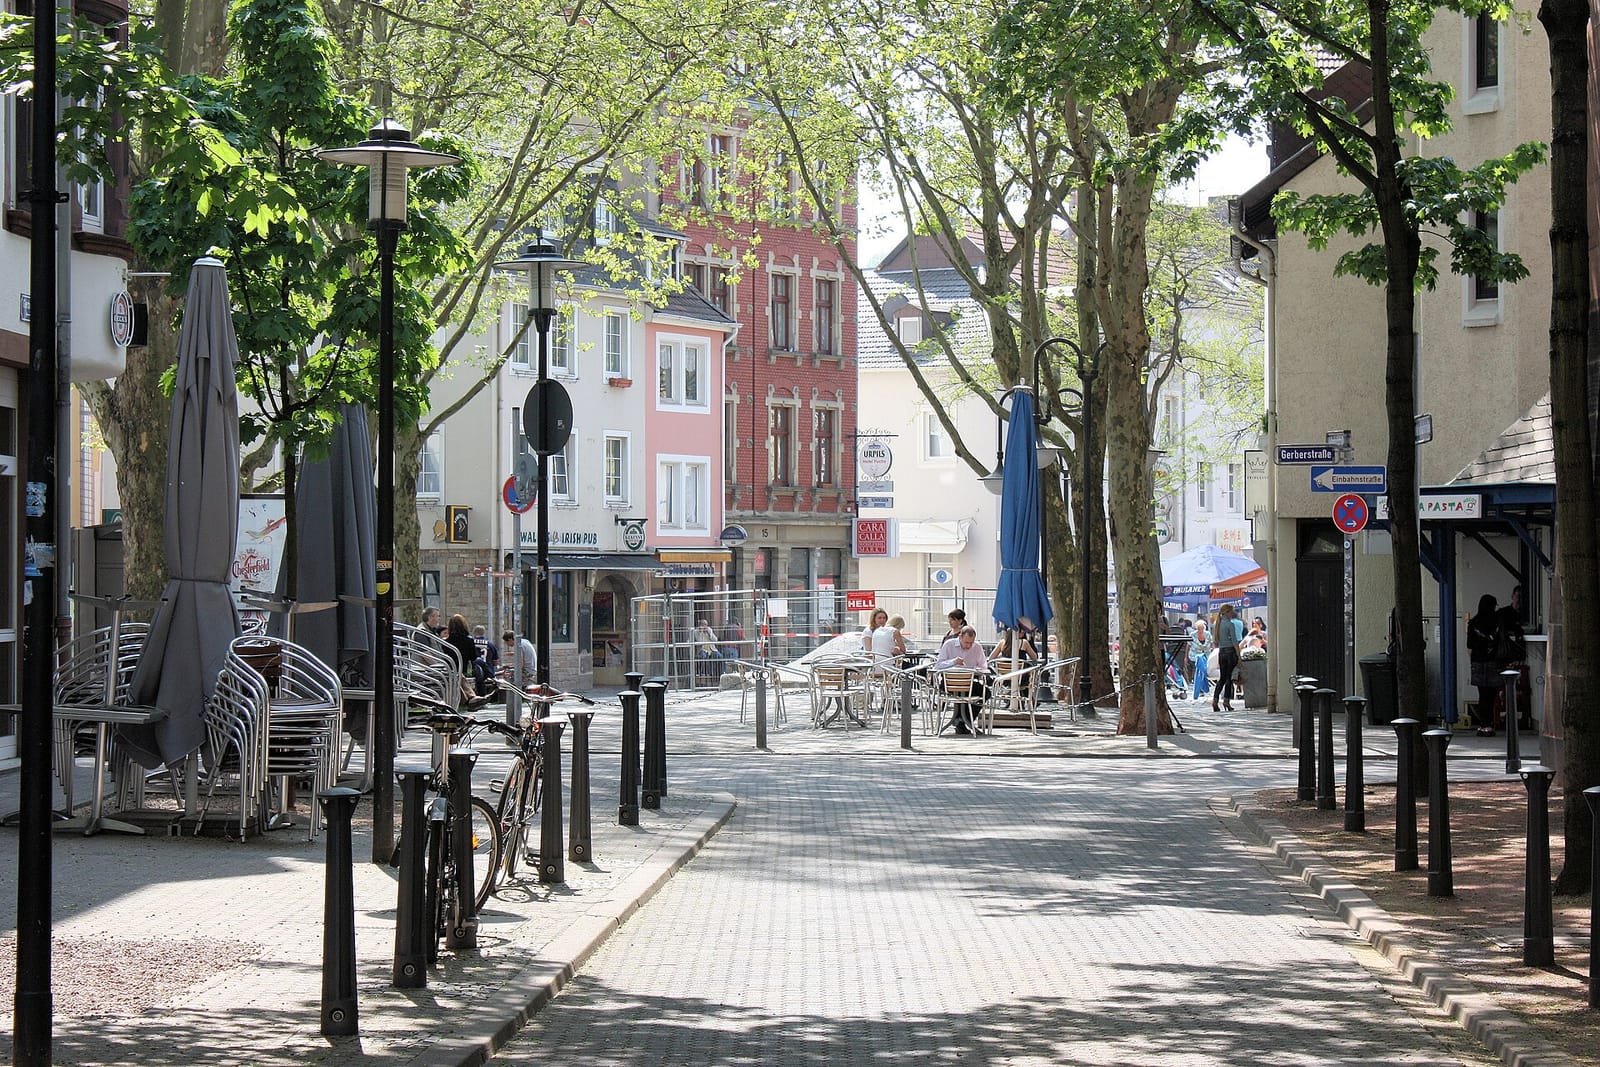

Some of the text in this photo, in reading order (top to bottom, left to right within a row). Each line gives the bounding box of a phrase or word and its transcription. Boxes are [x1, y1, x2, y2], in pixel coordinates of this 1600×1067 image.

[863, 450, 886, 458] URPILS
[1281, 449, 1332, 459] Gerberstraße
[1331, 475, 1382, 483] Einbahnstraße
[1427, 502, 1464, 512] PASTA
[859, 523, 884, 532] CARA
[761, 528, 769, 538] 15
[561, 532, 582, 544] IRISH
[583, 533, 598, 545] PUB
[1173, 585, 1206, 594] PAULANER
[847, 600, 875, 608] HELL
